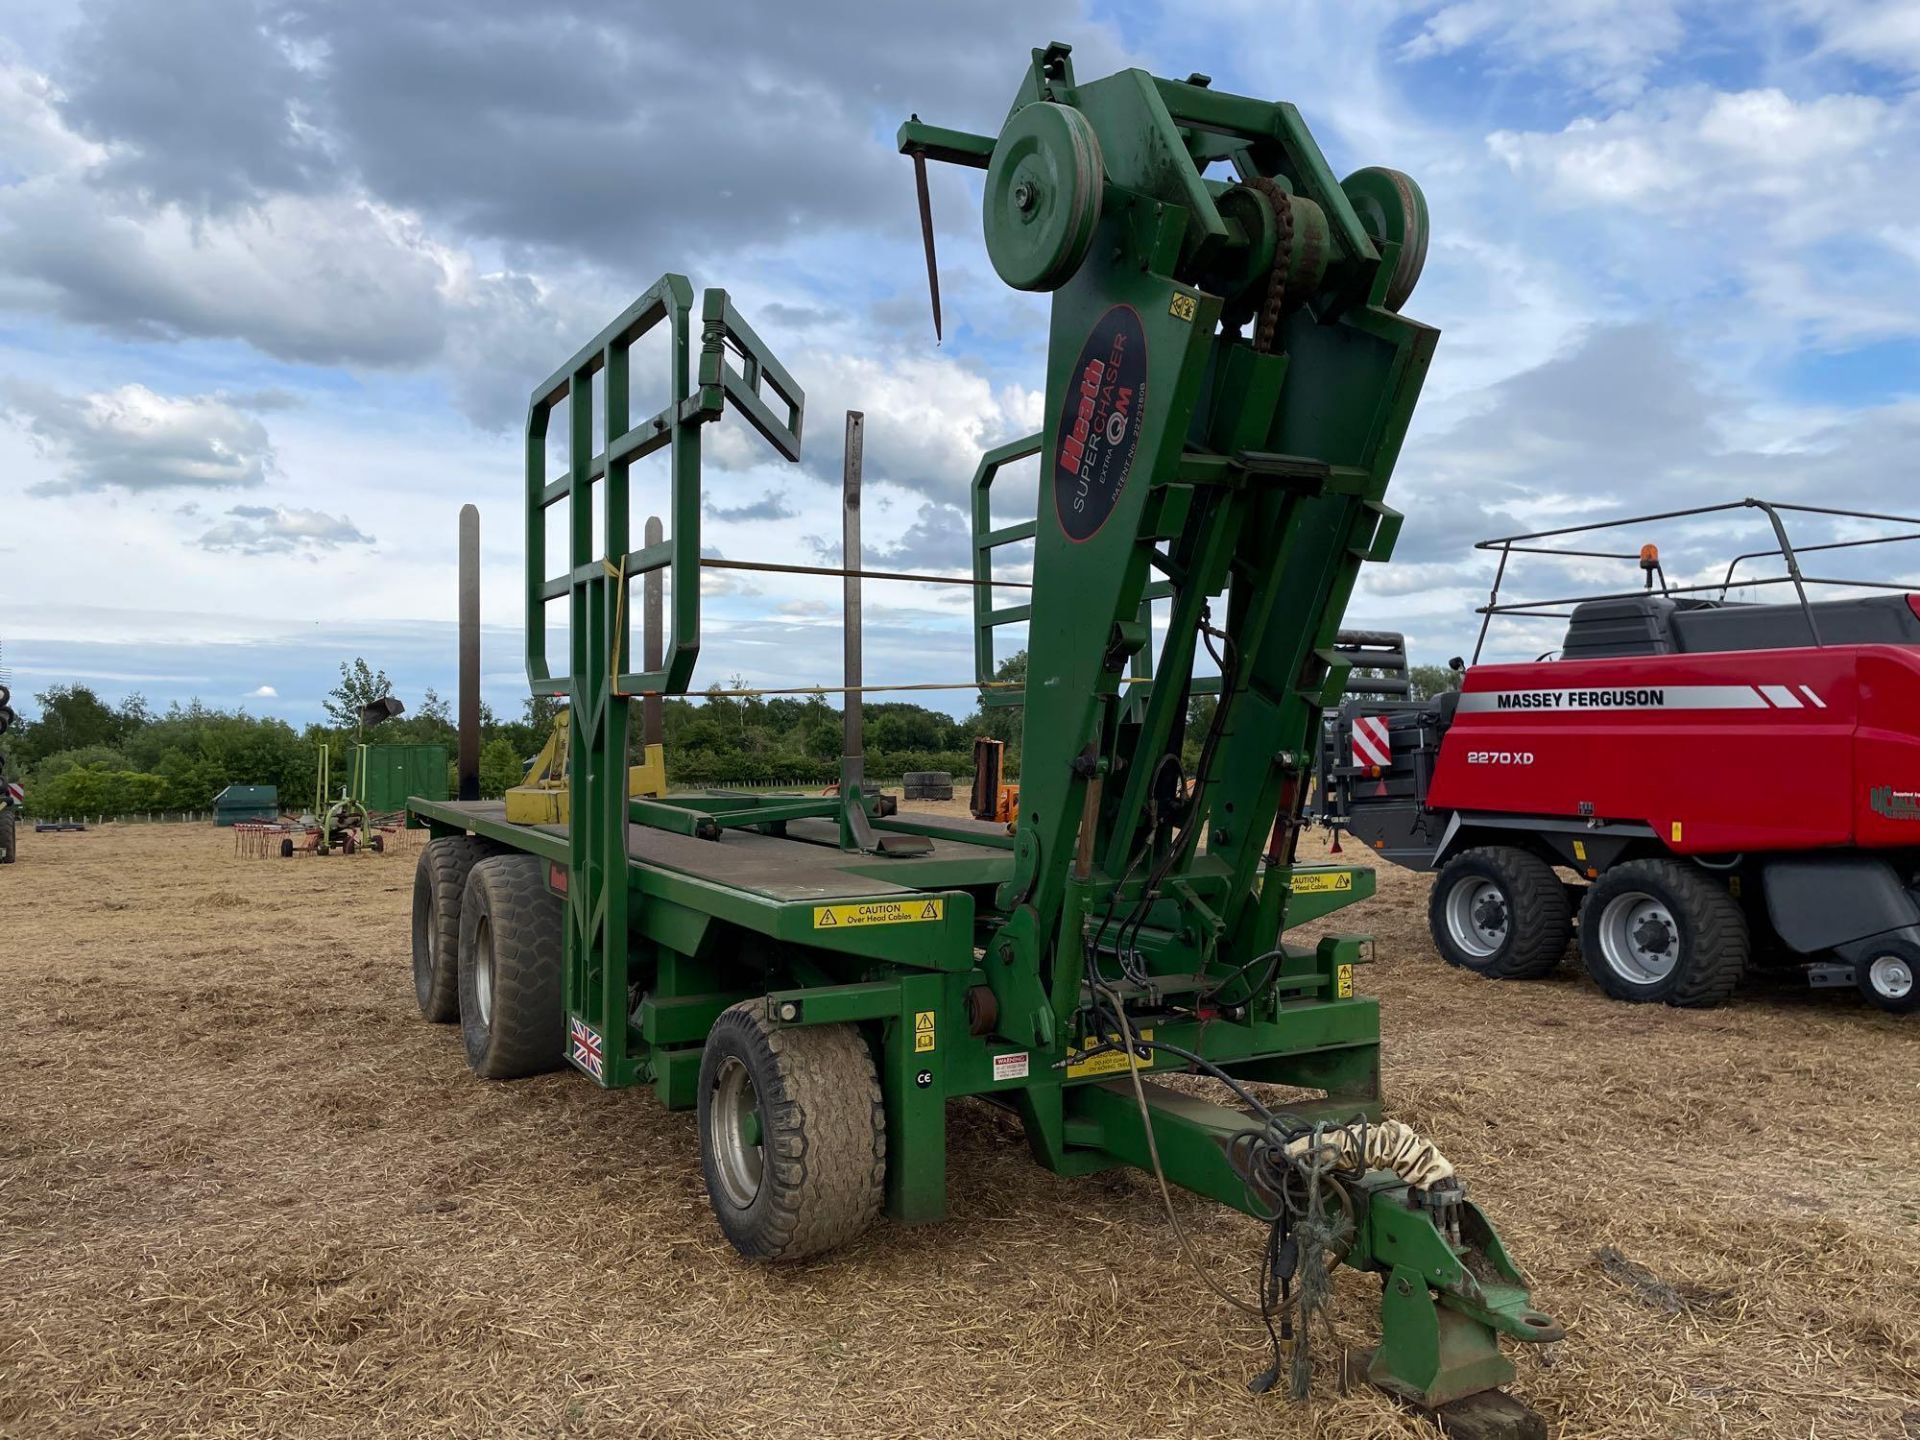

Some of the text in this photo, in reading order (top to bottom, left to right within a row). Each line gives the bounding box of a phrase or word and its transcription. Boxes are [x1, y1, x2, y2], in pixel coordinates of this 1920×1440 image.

[1060, 358, 1105, 475] Heath
[1099, 448, 1113, 485] EXTRA
[1112, 459, 1131, 502] PATENT
[1497, 689, 1665, 709] MASSEY FERGUSON
[847, 912, 912, 924] Over Head Cables
[858, 904, 901, 915] CAUTION
